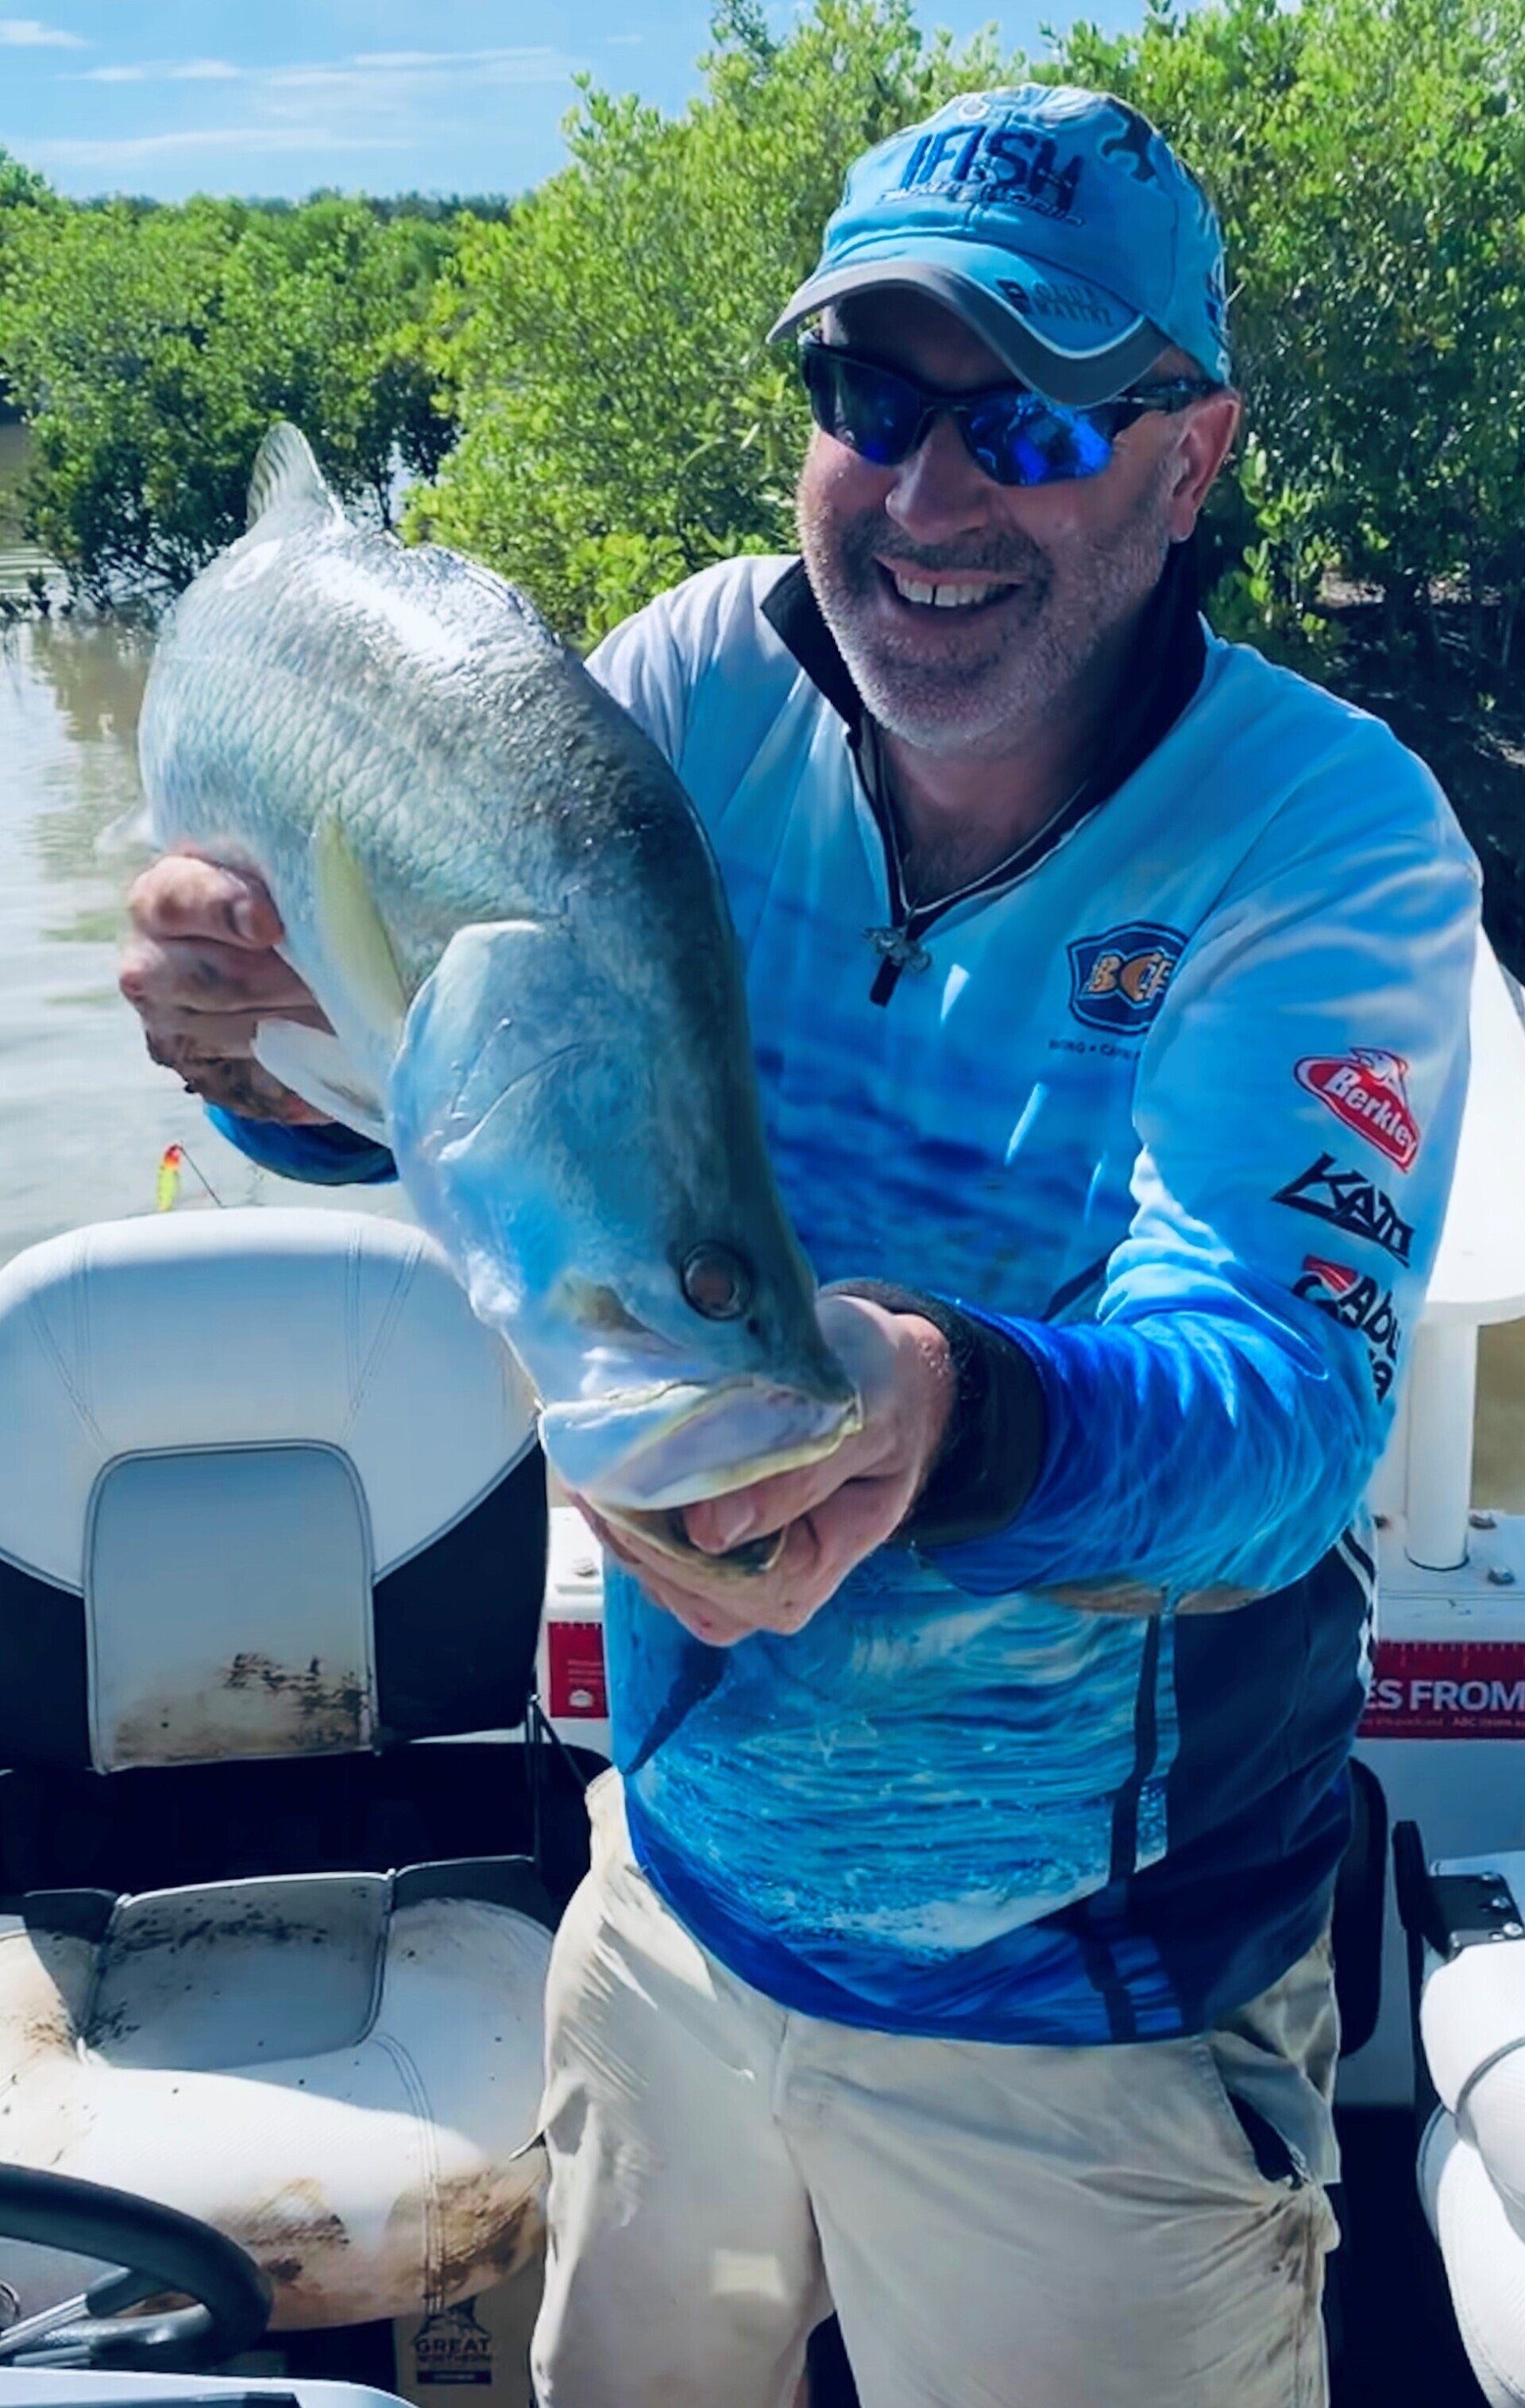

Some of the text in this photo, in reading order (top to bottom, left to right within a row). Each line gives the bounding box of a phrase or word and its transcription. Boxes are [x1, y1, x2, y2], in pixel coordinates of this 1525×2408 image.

[1323, 1066, 1418, 1154] Berkley
[1409, 1680, 1525, 1711] FROM
[415, 2338, 491, 2353] GREAT
